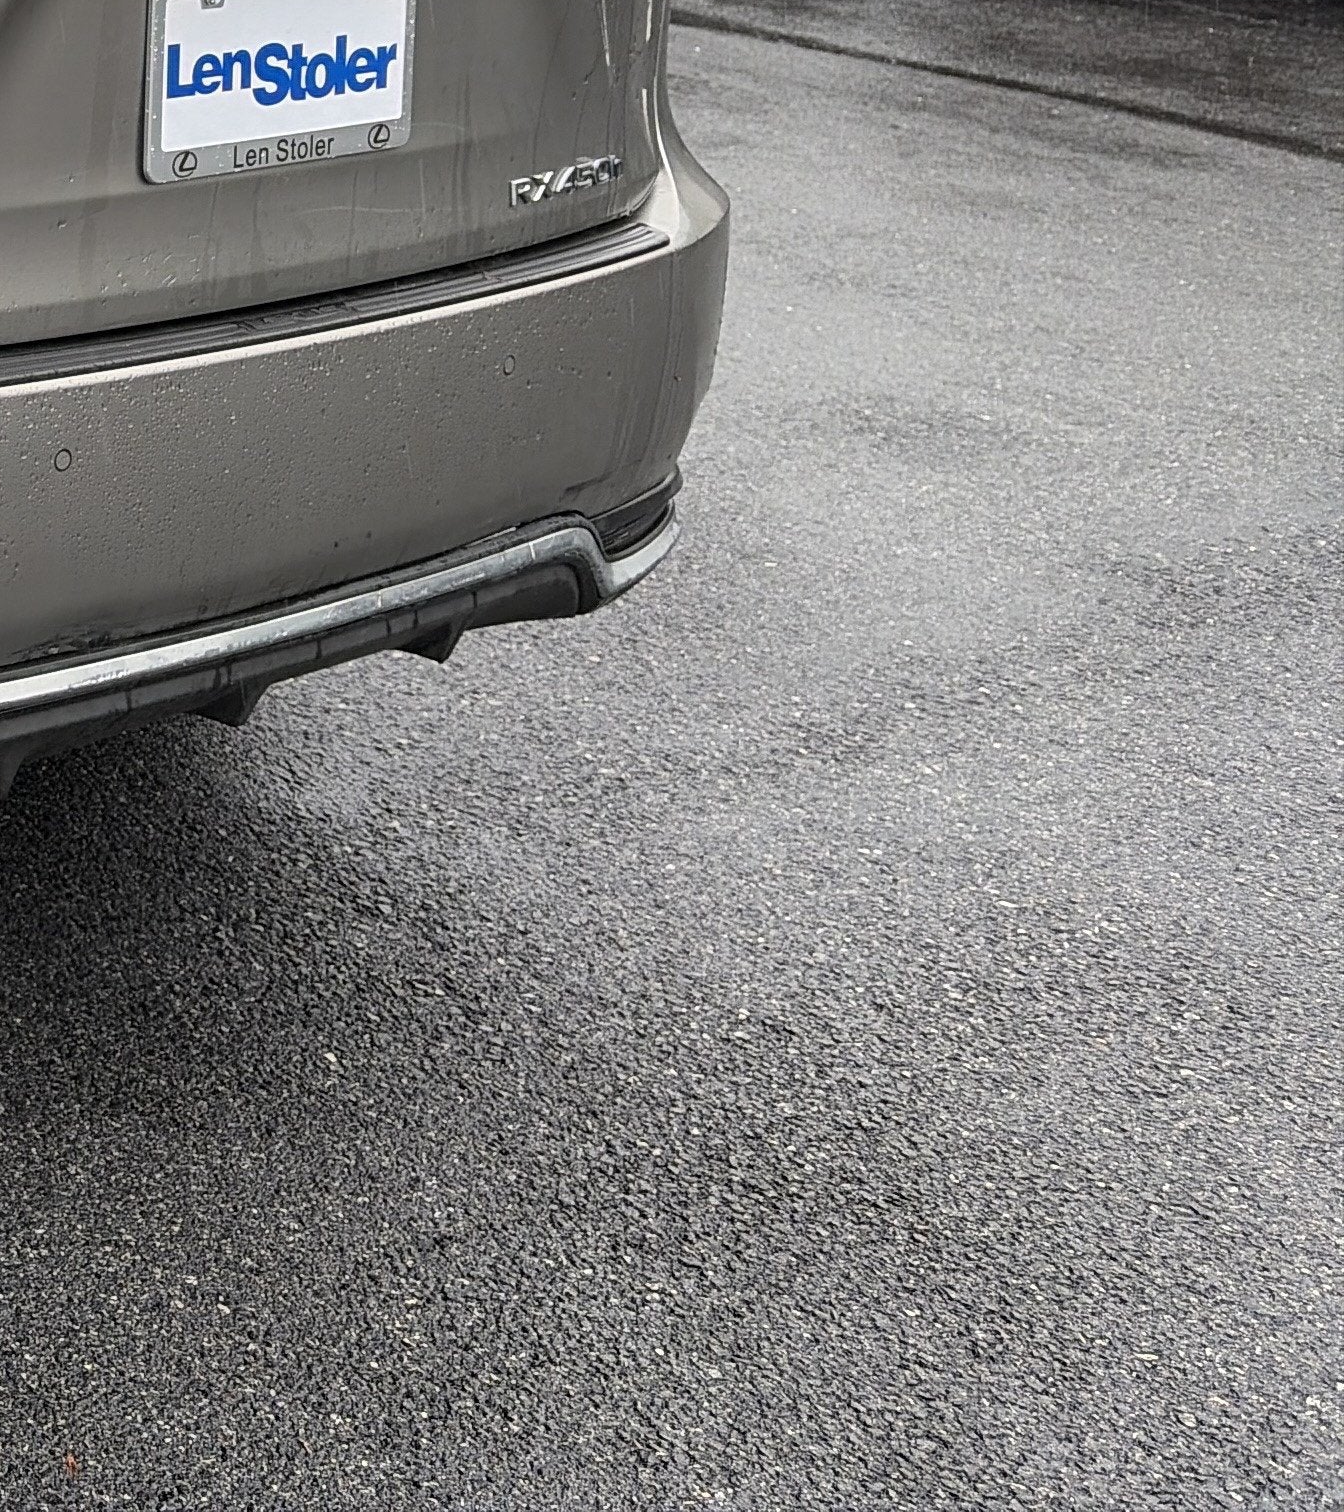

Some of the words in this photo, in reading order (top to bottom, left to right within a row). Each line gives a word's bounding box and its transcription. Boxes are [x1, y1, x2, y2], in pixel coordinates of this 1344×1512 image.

[166, 34, 398, 107] LenStoler
[233, 143, 269, 169] Len
[275, 134, 335, 163] Stoler
